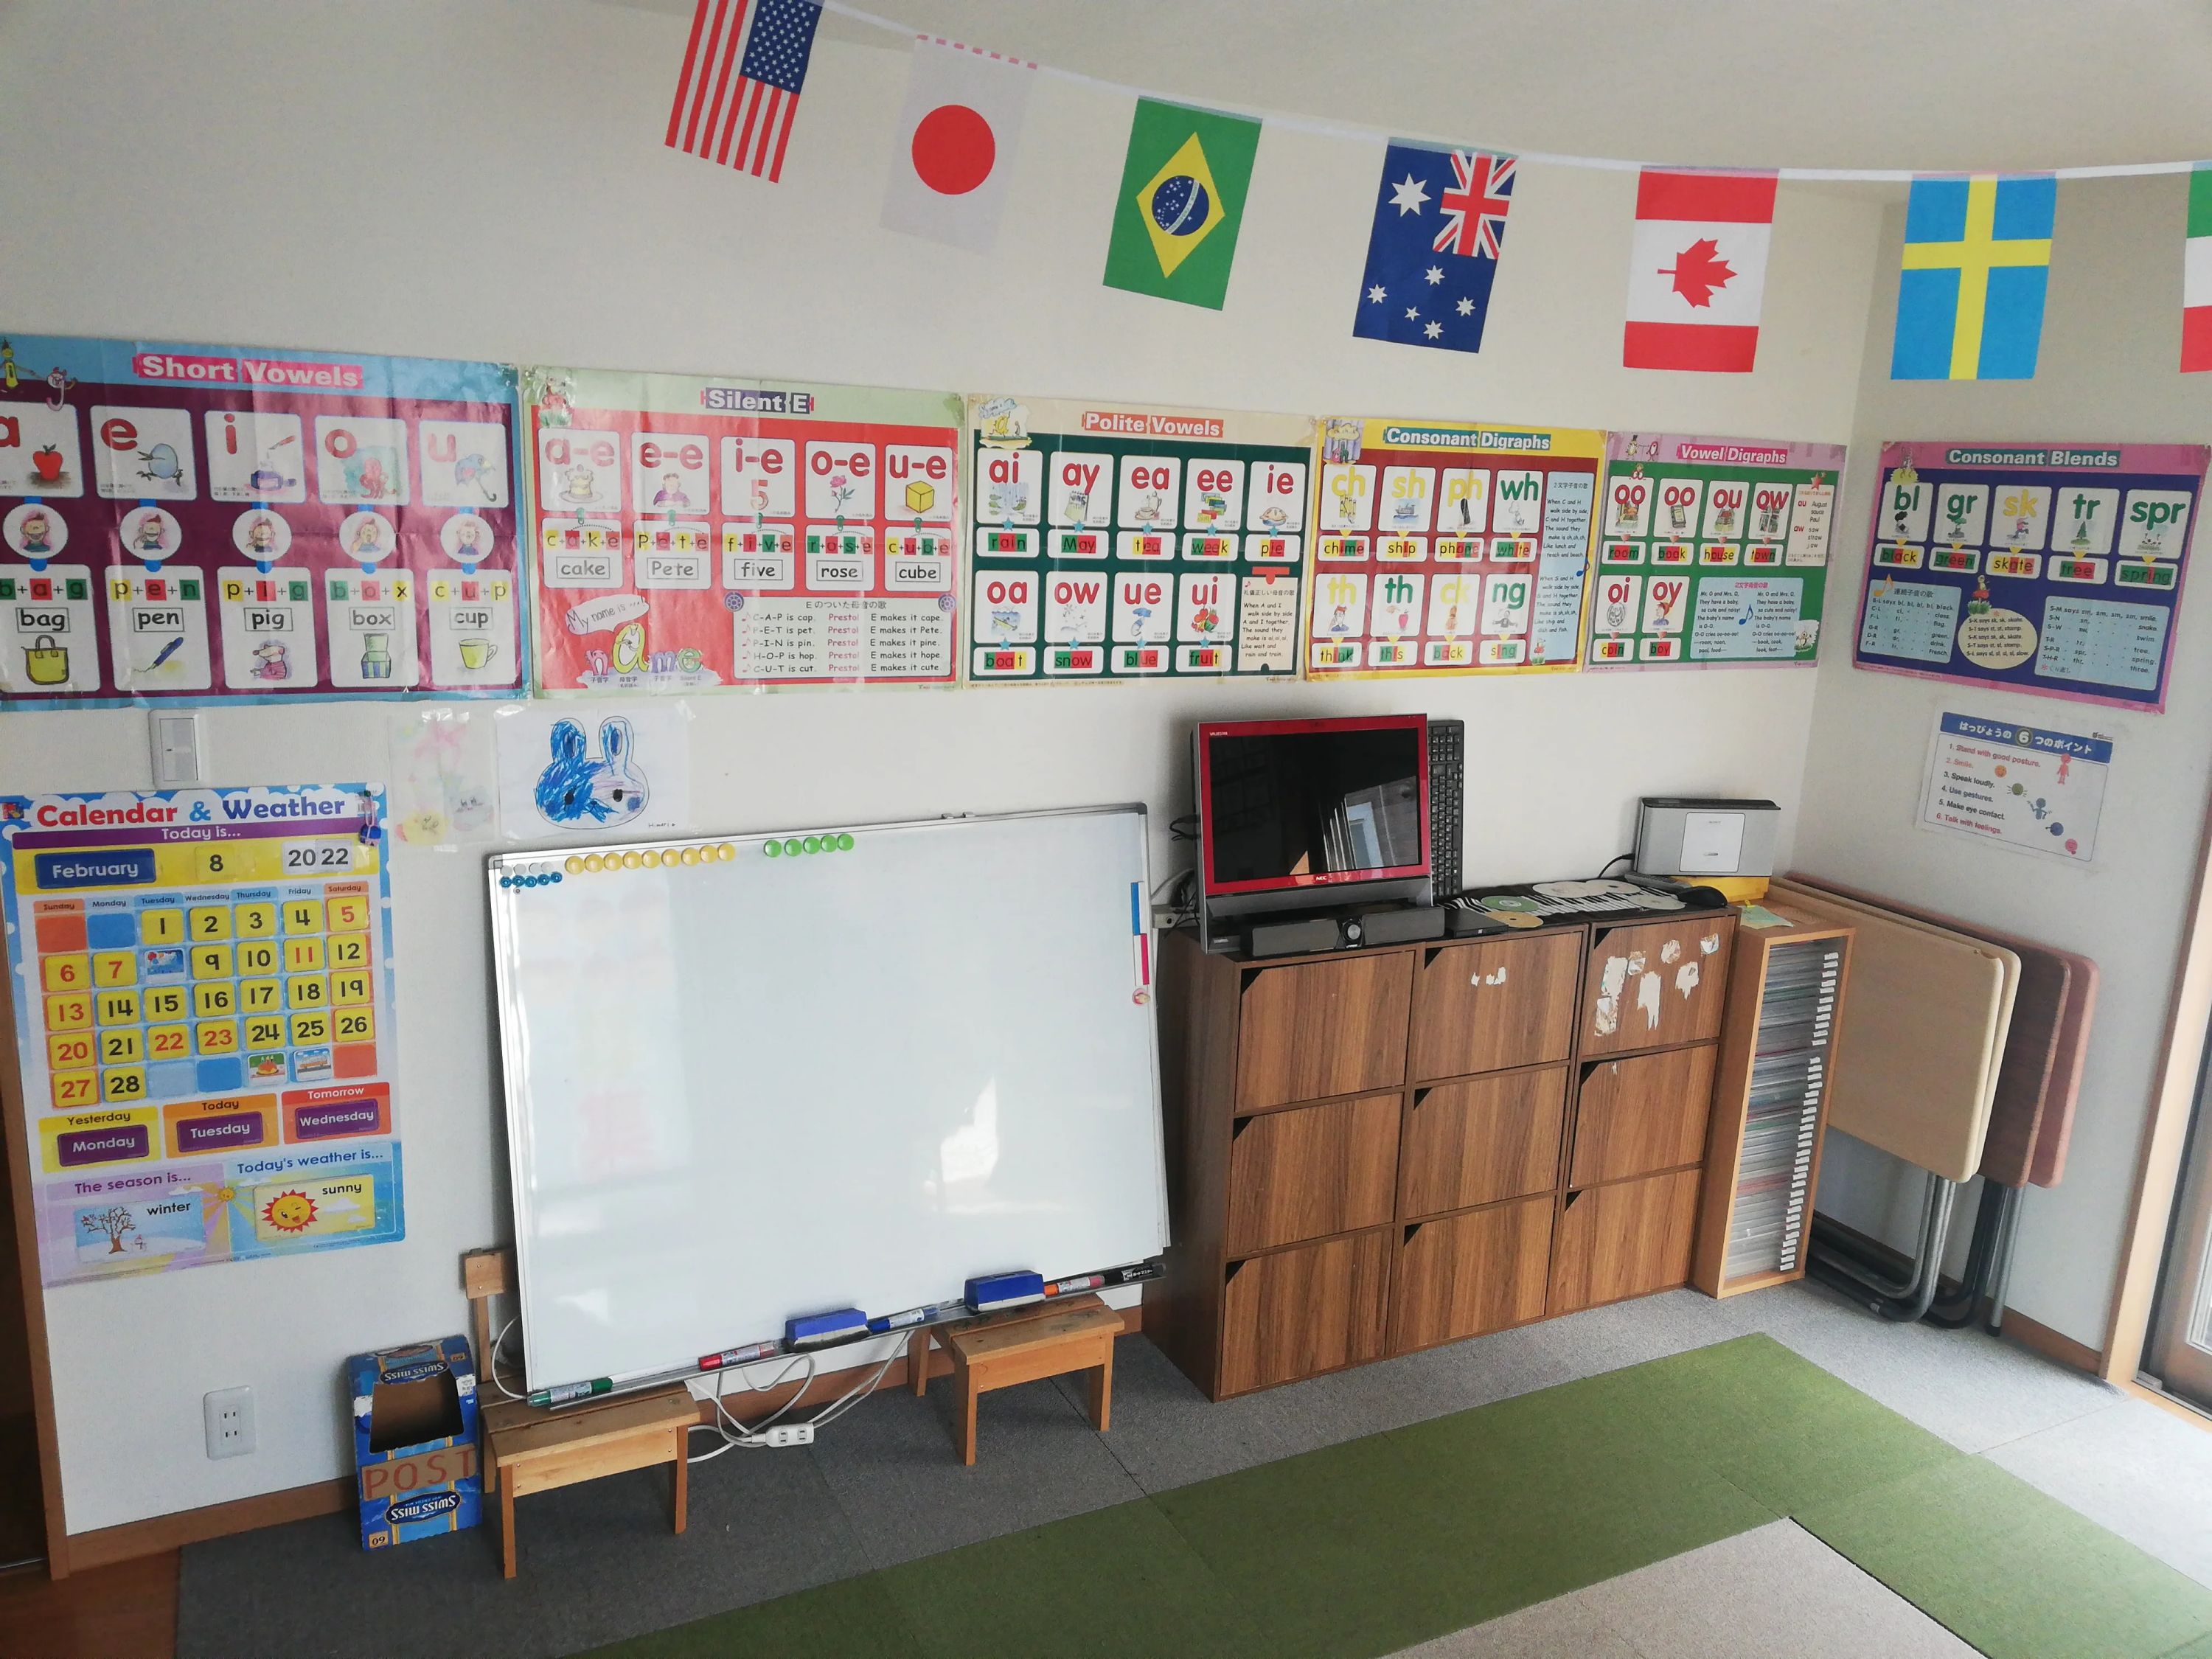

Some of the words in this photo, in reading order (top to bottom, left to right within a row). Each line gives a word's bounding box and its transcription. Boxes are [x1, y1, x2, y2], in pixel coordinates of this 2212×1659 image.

[142, 356, 235, 381] Short
[243, 361, 358, 387] Vowels
[709, 391, 782, 411] Silent
[793, 394, 808, 411] E
[224, 414, 237, 453] i
[1085, 413, 1144, 432] Polite
[1151, 417, 1220, 437] Vowels
[101, 419, 138, 451] e
[324, 429, 357, 458] o
[1386, 428, 1476, 446] Consonant
[1482, 432, 1550, 451] Digraphs
[427, 433, 456, 462] u
[641, 442, 703, 470] e-e
[735, 438, 783, 473] i-e
[1682, 445, 1724, 460] Vowel
[1728, 448, 1786, 464] Digraphs
[811, 451, 870, 476] o-e
[889, 453, 946, 479] u-e
[1950, 450, 2044, 465] Consonant
[2051, 451, 2118, 466] Blends
[989, 452, 1019, 484] ai
[1062, 462, 1100, 495] ay
[1131, 466, 1169, 490] ea
[1197, 469, 1232, 492] ee
[1267, 465, 1293, 494] ie
[1332, 467, 1366, 497] ch
[1392, 469, 1425, 498] sh
[1500, 473, 1539, 501] wh
[1448, 471, 1482, 507] ph
[1664, 487, 1695, 507] oo
[1714, 489, 1742, 509] ou
[1756, 490, 1790, 511] ow
[1893, 485, 1920, 512] bl
[1947, 493, 1978, 521] gr
[2003, 489, 2037, 518] sk
[2073, 494, 2100, 519] tr
[2130, 501, 2186, 530] spr
[992, 536, 1027, 551] rain
[1062, 537, 1094, 554] May
[1192, 540, 1228, 554] week
[1324, 541, 1364, 555] chime
[1388, 542, 1416, 557] ship
[1705, 547, 1734, 561] house
[1881, 549, 1917, 563] black
[561, 561, 605, 576] cake
[652, 562, 694, 577] Pete
[741, 561, 780, 579] five
[821, 565, 858, 578] rose
[899, 566, 936, 579] cube
[1994, 556, 2033, 571] skate
[987, 581, 1027, 605] oa
[1054, 582, 1099, 605] ow
[1192, 577, 1218, 605] ui
[1327, 575, 1357, 605] th
[1385, 575, 1413, 604] th
[1492, 581, 1526, 610] ng
[1608, 577, 1630, 603] oi
[1652, 581, 1683, 608] oy
[21, 611, 66, 630] bag
[138, 611, 180, 629] pen
[251, 610, 285, 629] pig
[353, 608, 391, 625] box
[454, 611, 488, 628] cup
[568, 610, 589, 633] My
[591, 605, 615, 622] name
[619, 602, 625, 611] is
[921, 615, 943, 624] cape.
[1651, 642, 1670, 655] boy
[1055, 654, 1091, 667] snow
[2017, 731, 2031, 742] 6
[1956, 745, 1976, 754] Stand
[1978, 748, 1991, 757] with
[1992, 753, 2010, 763] good
[2012, 756, 2040, 768] posture.
[1952, 773, 1972, 783] Speak
[1974, 776, 1995, 788] loudly.
[1950, 786, 1961, 795] Use
[37, 804, 178, 827] Calendar
[189, 801, 211, 822] &
[223, 796, 345, 820] Weather
[1947, 801, 1964, 810] Make
[1966, 805, 1977, 814] eye
[1944, 814, 1958, 824] Talk
[1960, 817, 1973, 827] with
[162, 827, 212, 841] Today
[216, 826, 241, 839] is...
[52, 863, 139, 880] February
[209, 855, 223, 872] 8
[185, 893, 229, 902] Wednesday
[237, 890, 271, 900] Thursday
[288, 887, 311, 897] Friday
[327, 884, 361, 894] Saturday
[43, 902, 74, 911] Sunday
[92, 899, 126, 908] Monday
[142, 896, 175, 905] Tuesday
[204, 917, 219, 933] 2
[247, 950, 271, 967] 10
[108, 961, 123, 979] 7
[58, 1004, 84, 1022] 13
[251, 1024, 280, 1043] 24
[58, 1043, 88, 1062] 20
[110, 1076, 140, 1094] 28
[307, 1086, 364, 1099] Tomorrow
[202, 1099, 240, 1111] Today
[67, 1111, 131, 1127] Yesterday
[299, 1110, 374, 1127] Wednesday
[191, 1122, 251, 1138] Tuesday
[73, 1135, 135, 1152] Monday
[237, 1157, 293, 1175] Today's
[297, 1150, 358, 1166] weather
[361, 1148, 383, 1161] is...
[74, 1182, 105, 1194] The
[108, 1176, 162, 1191] season
[167, 1172, 191, 1183] is...
[322, 1183, 362, 1197] sunny
[147, 1202, 191, 1217] winter
[364, 1449, 476, 1499] POST
